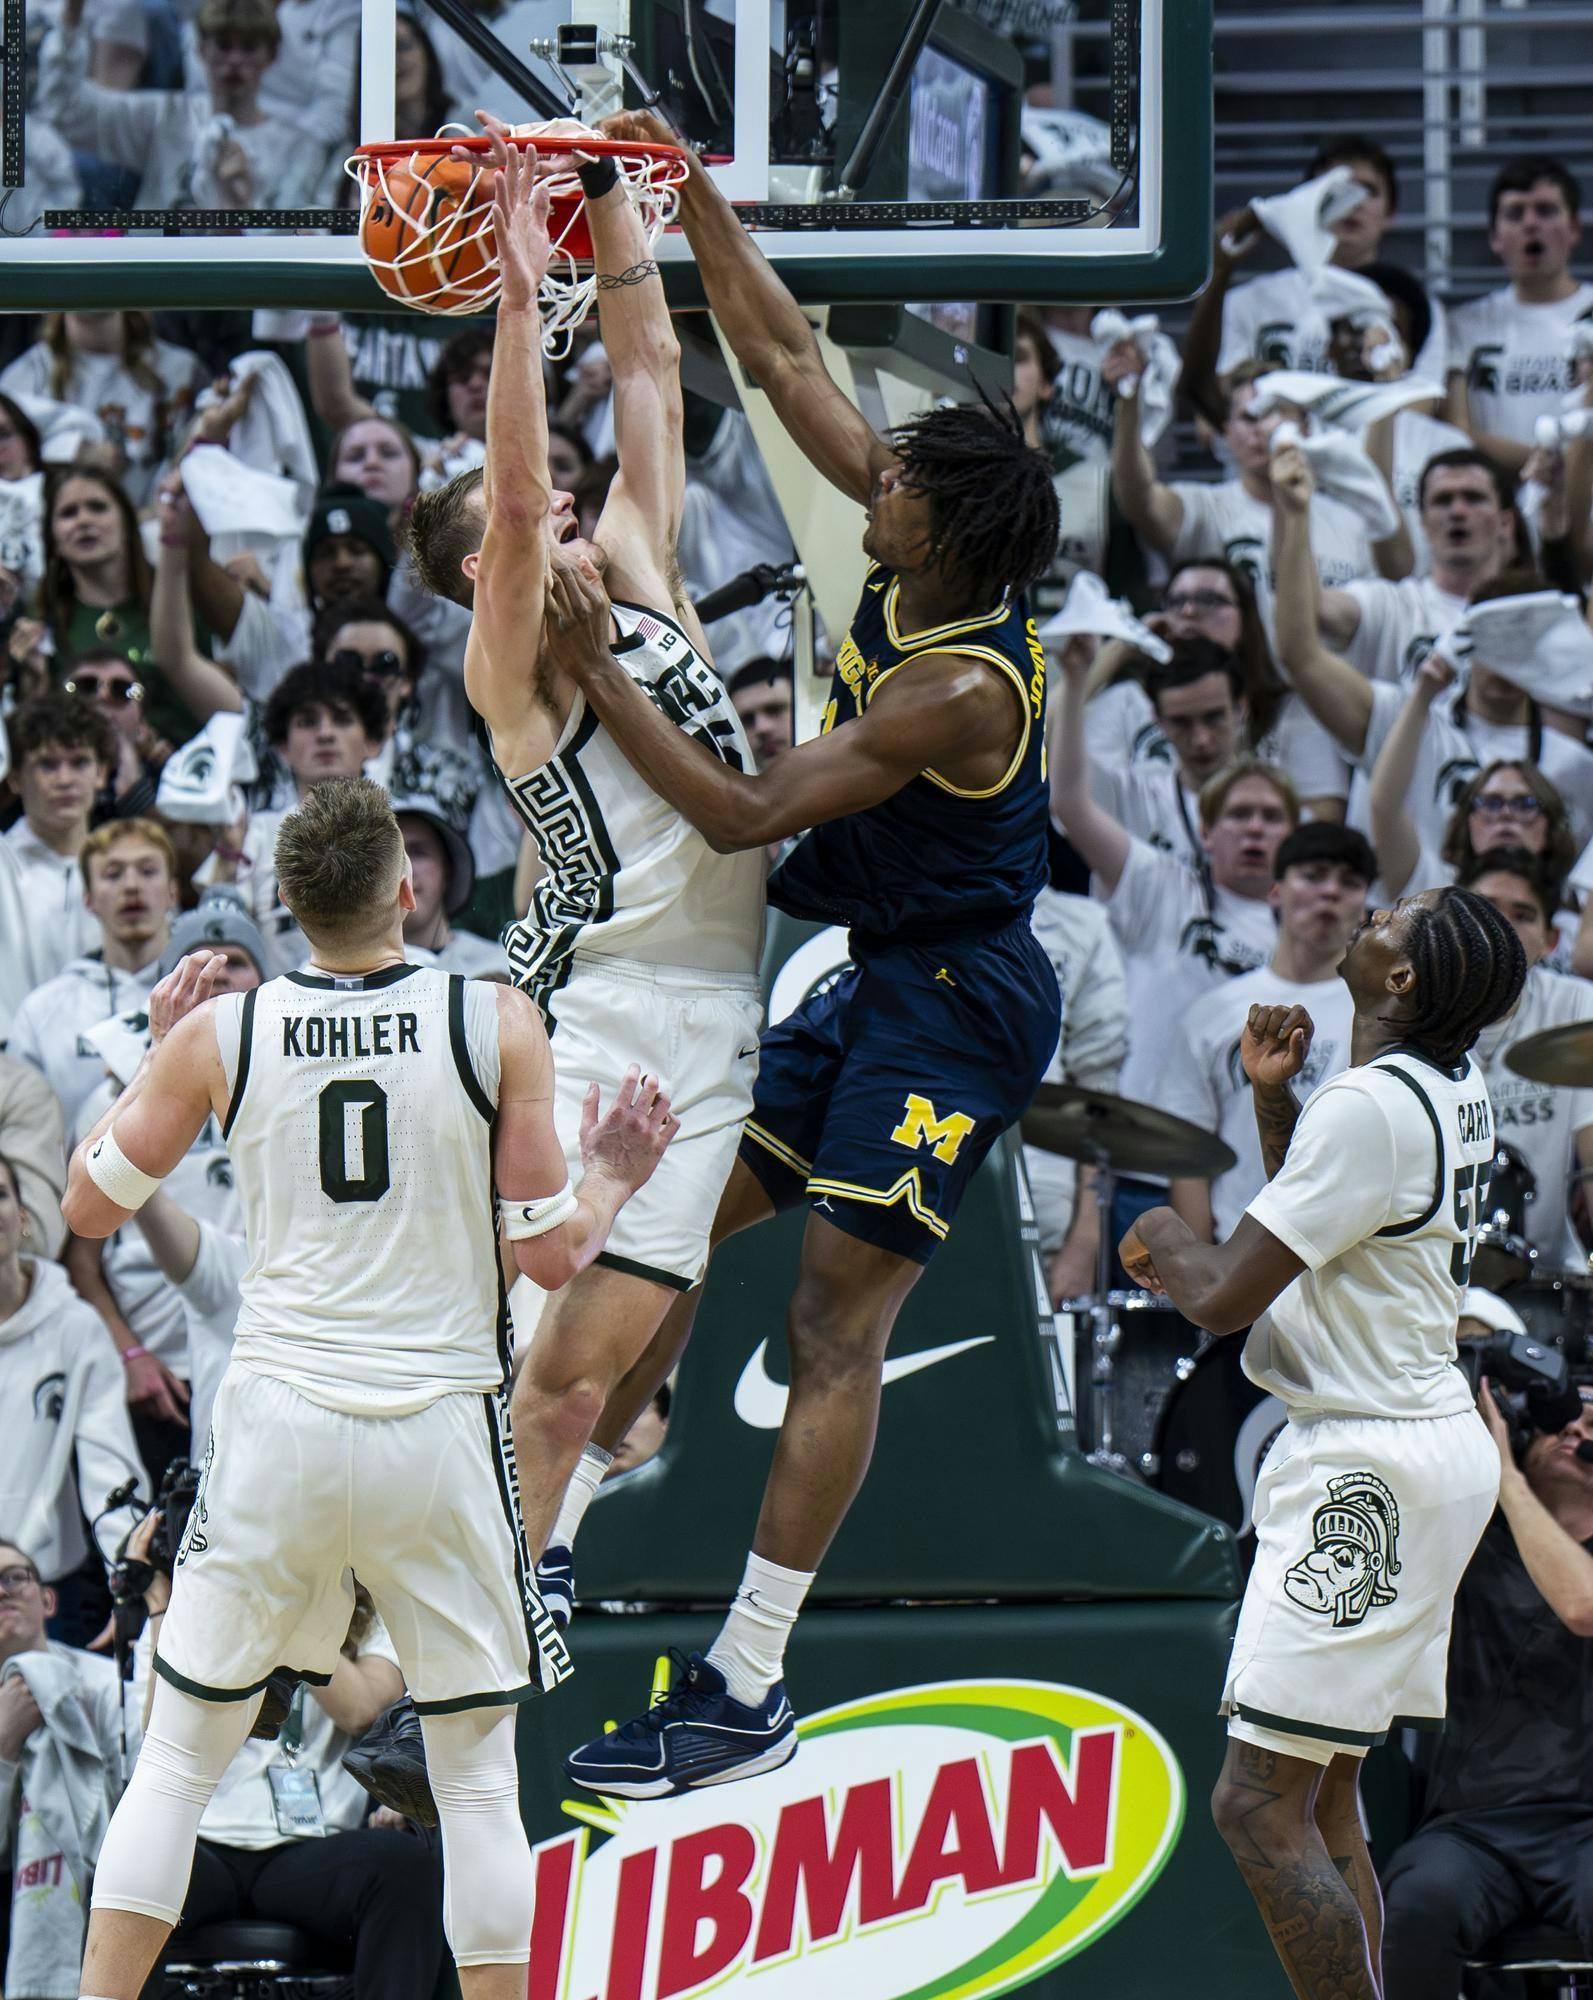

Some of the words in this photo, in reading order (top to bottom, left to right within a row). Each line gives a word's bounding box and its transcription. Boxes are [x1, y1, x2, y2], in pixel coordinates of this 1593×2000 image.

[282, 1012, 421, 1058] KOHLER
[318, 1079, 391, 1204] 0
[890, 1093, 976, 1167] M
[1457, 1099, 1491, 1145] CARR
[528, 1731, 1116, 2000] LIBMAN
